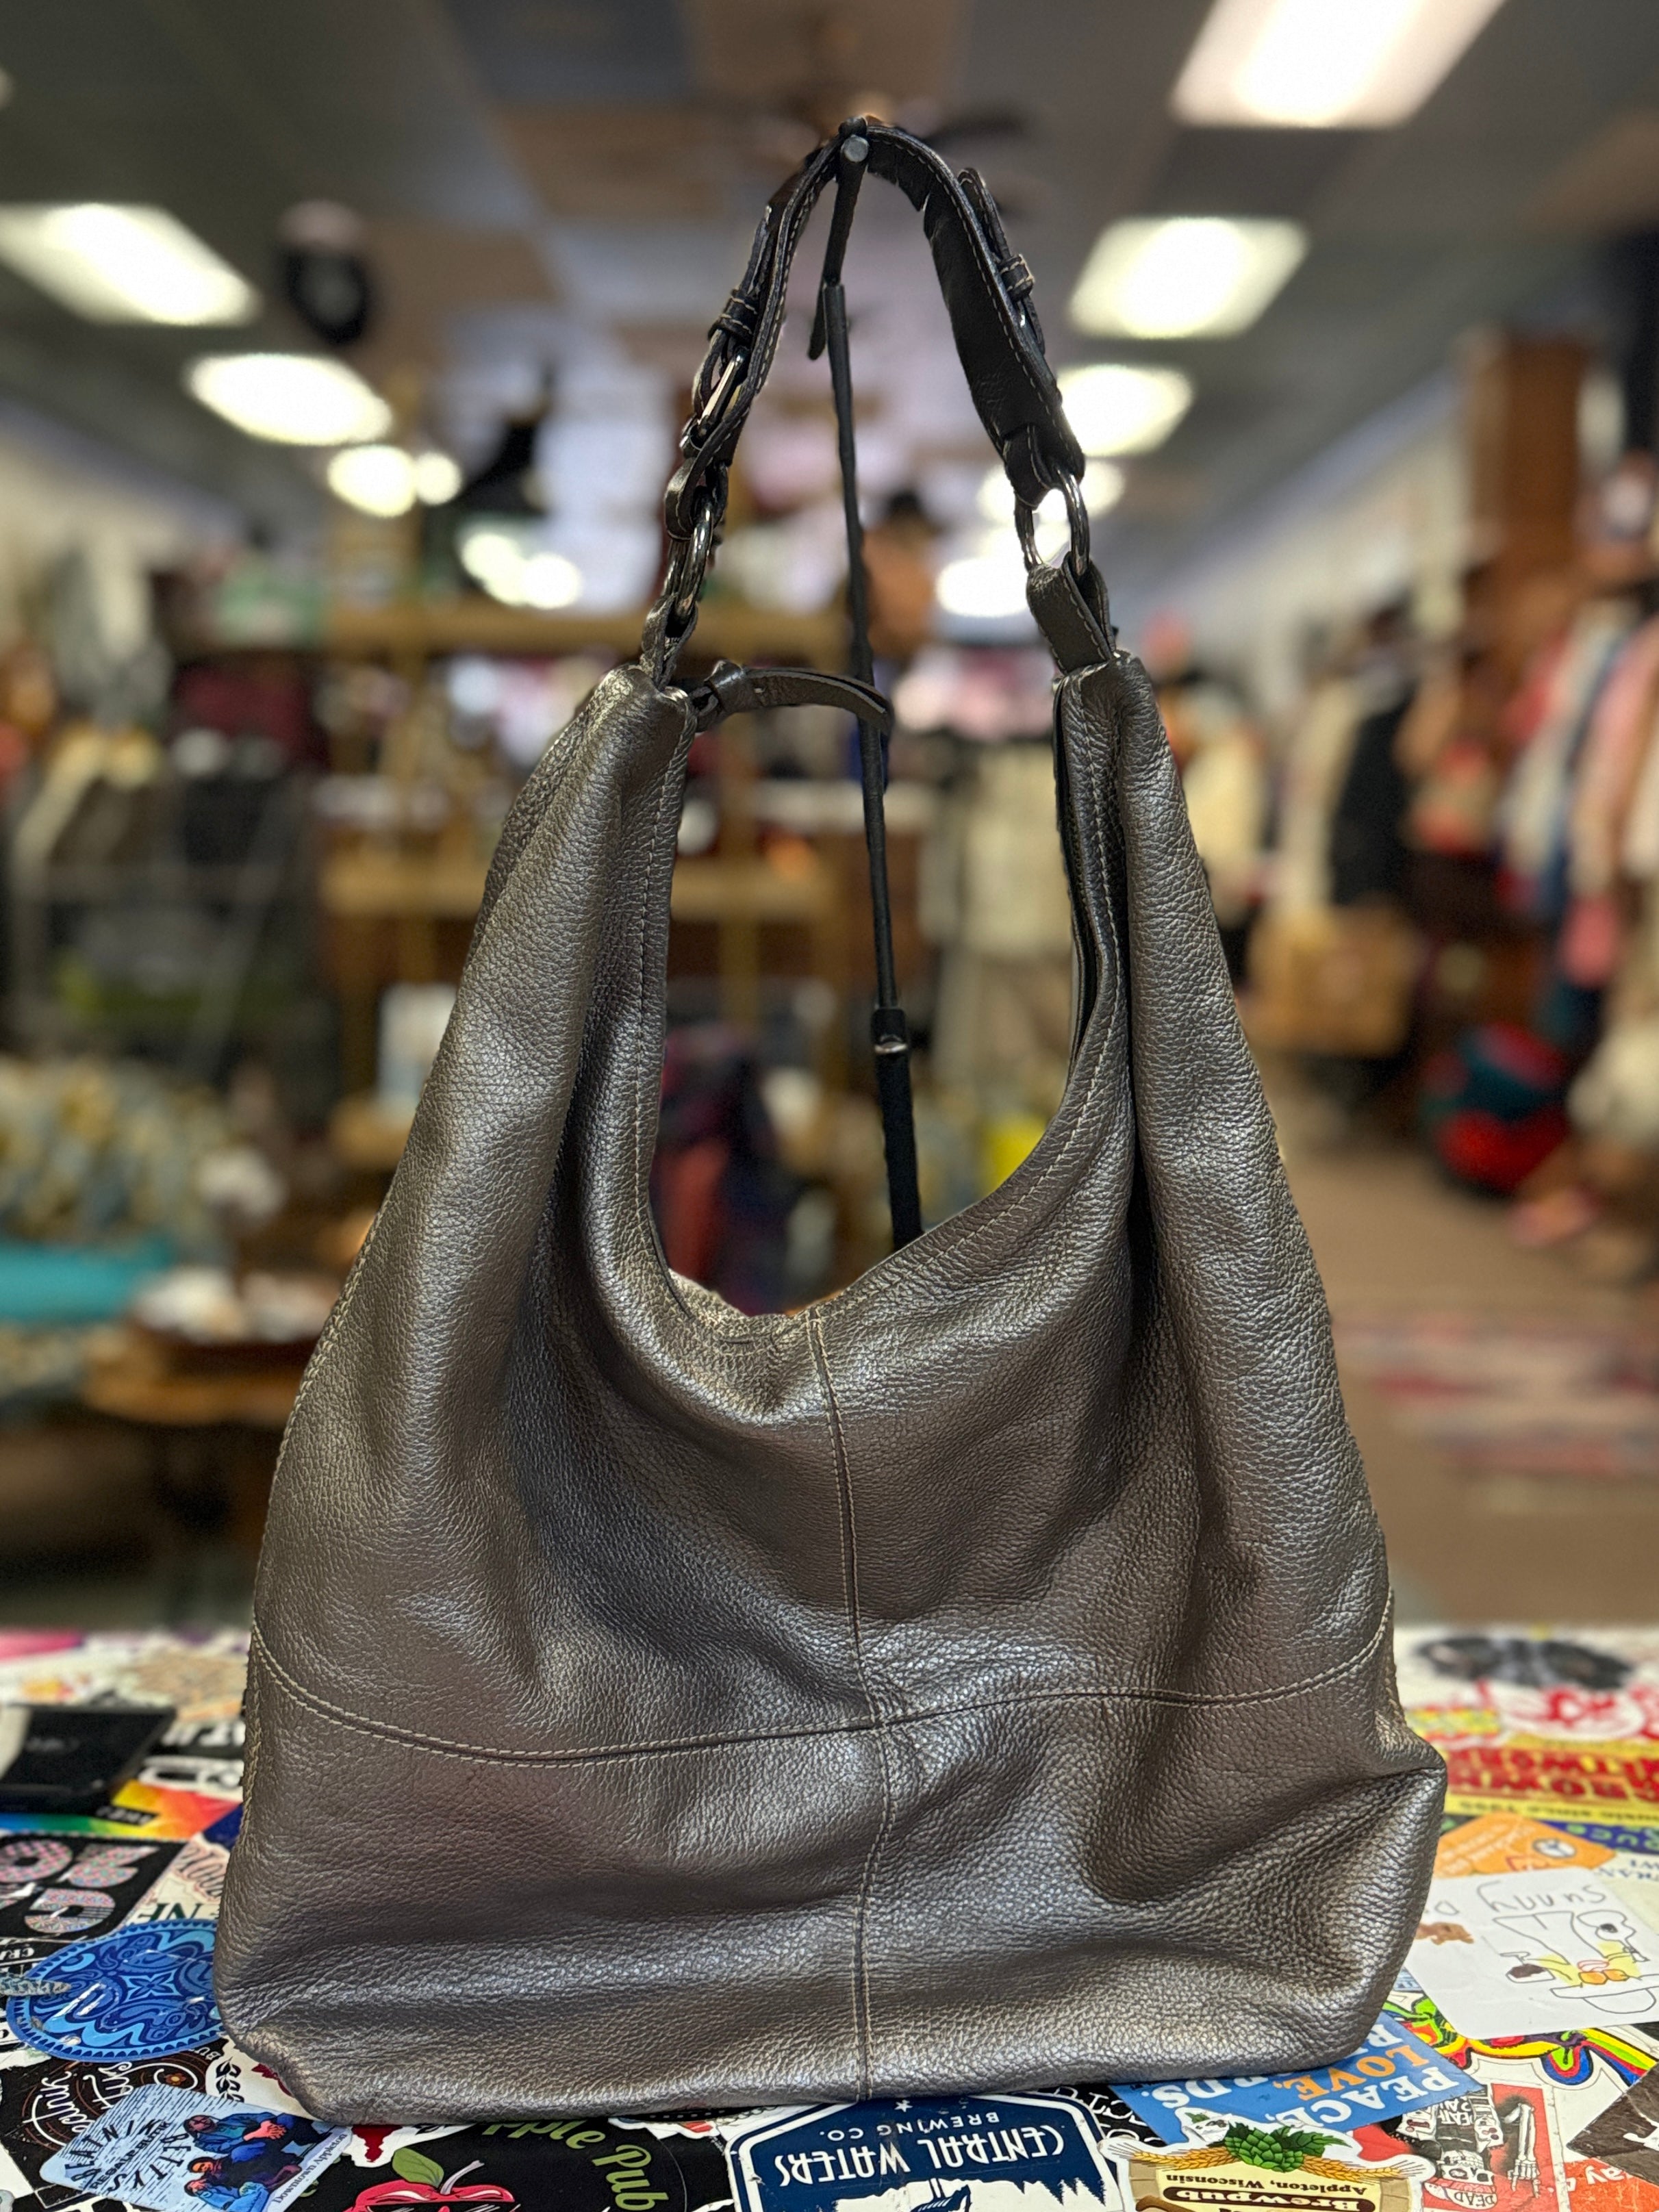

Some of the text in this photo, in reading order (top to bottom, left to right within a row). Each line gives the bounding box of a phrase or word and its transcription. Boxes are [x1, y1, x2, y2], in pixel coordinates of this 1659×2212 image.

[1271, 2044, 1429, 2101] LOVE,
[818, 2111, 1000, 2141] BREWING CO.
[774, 2141, 910, 2187] WATERS
[917, 2124, 1064, 2169] CENTRAL
[273, 2133, 349, 2204] Downtown Appleton
[592, 2144, 670, 2212] Pub
[1166, 2174, 1367, 2196] Appleton, Wisconsin
[1585, 2165, 1634, 2185] ay
[1176, 2190, 1360, 2212] Brewpub
[1453, 2191, 1494, 2207] DEAD
